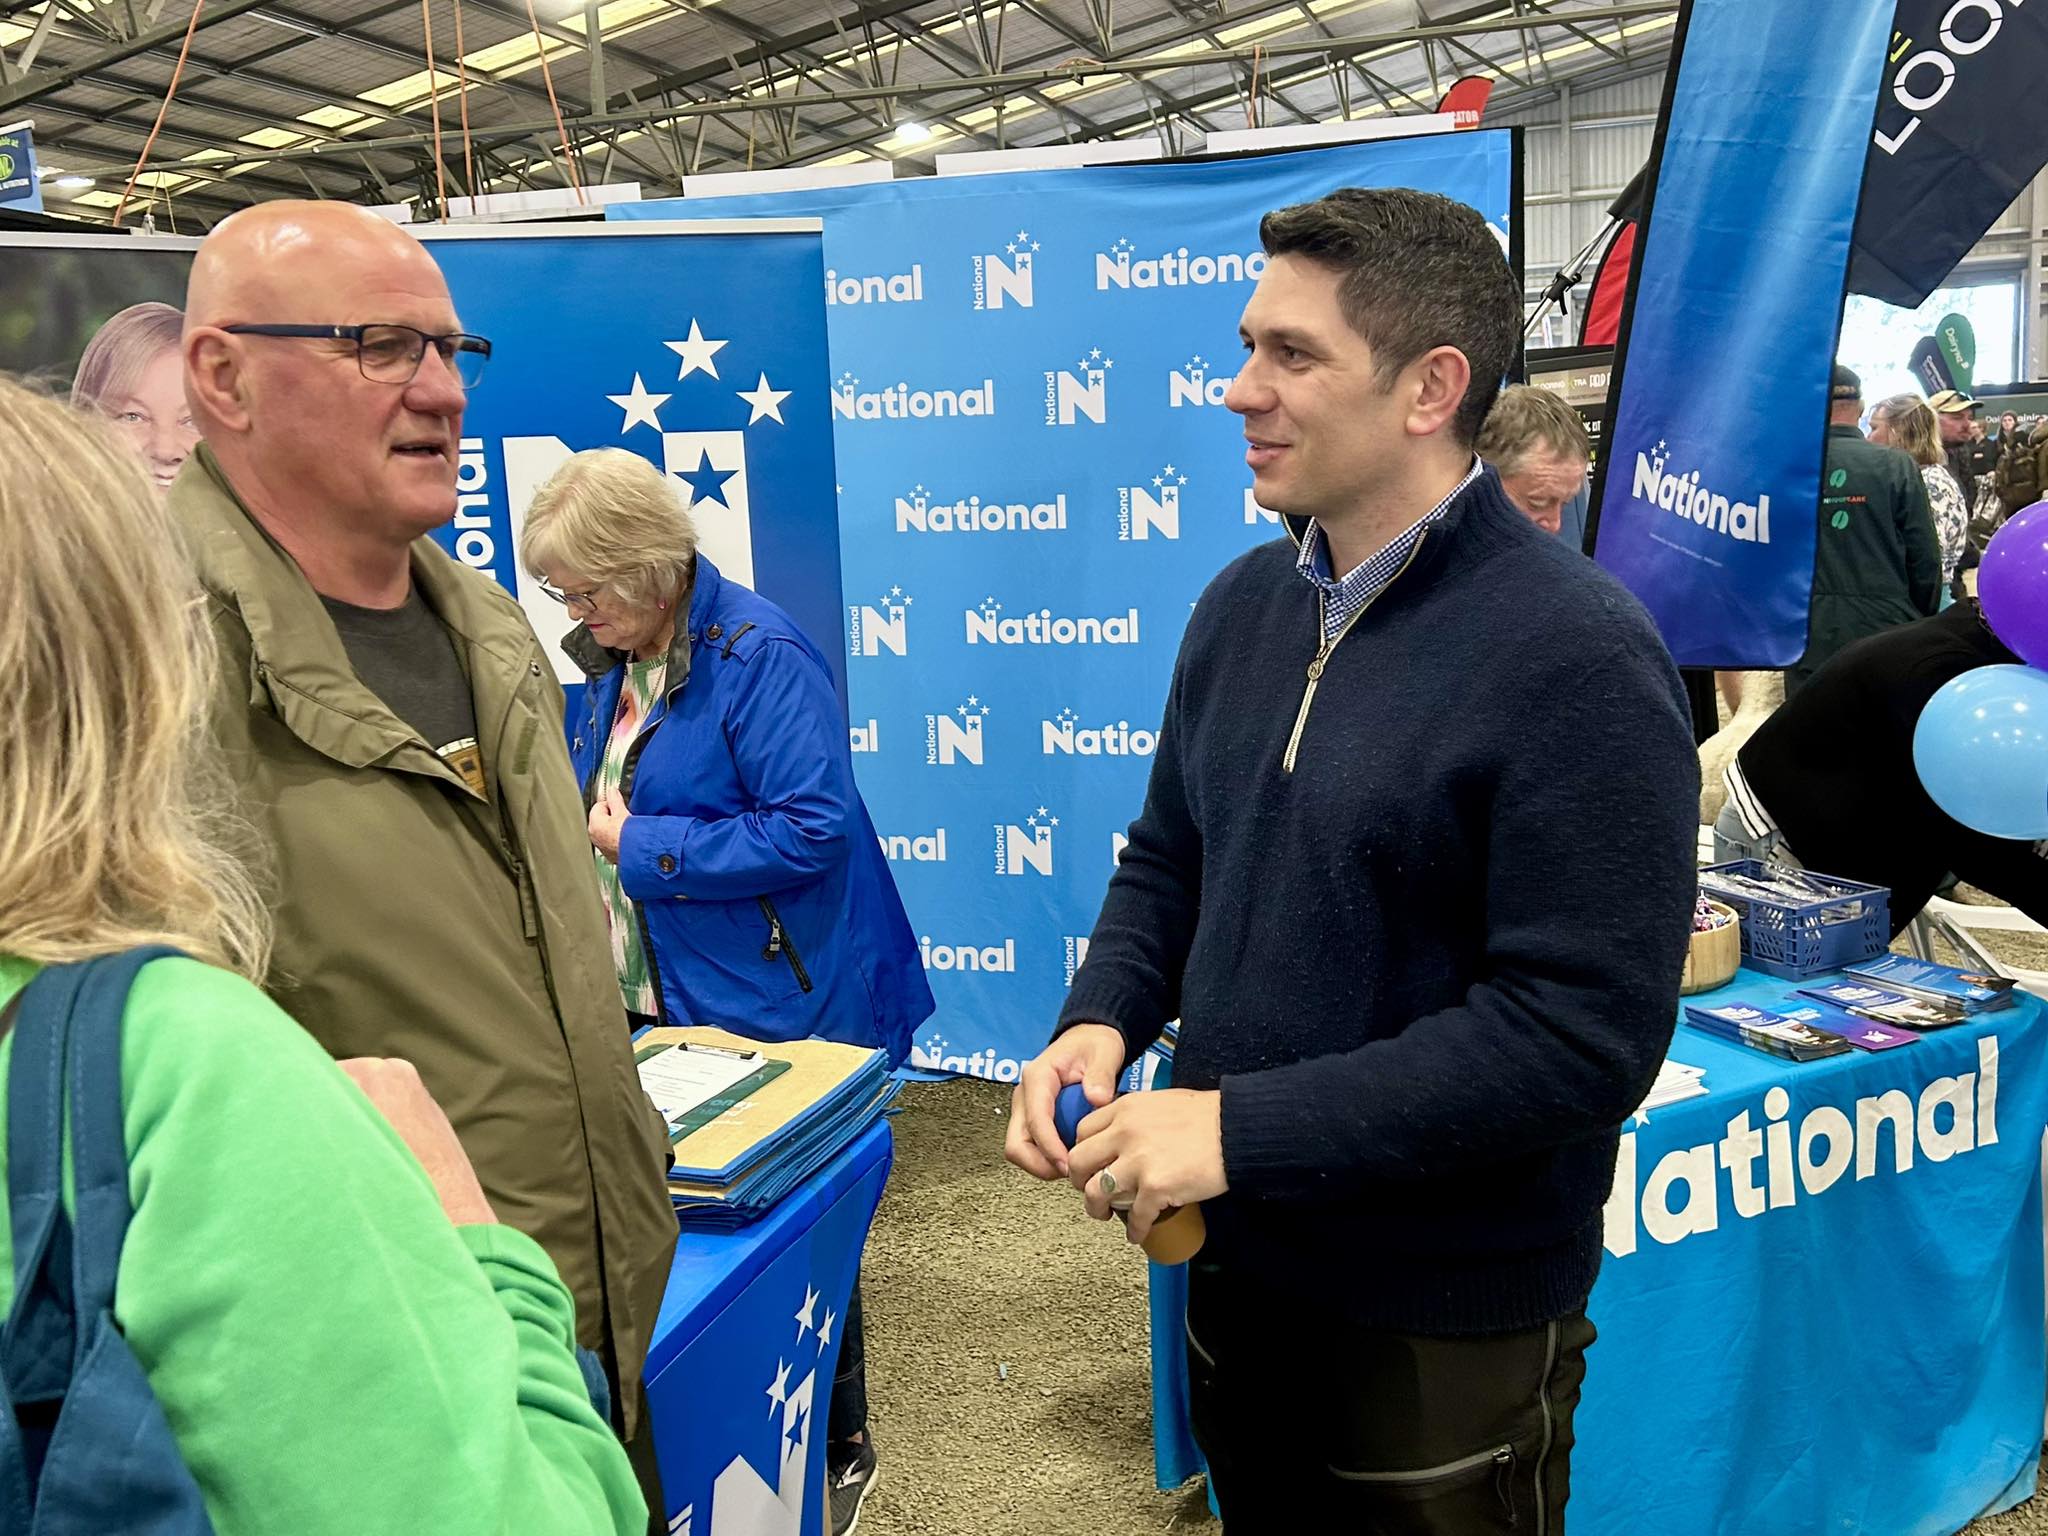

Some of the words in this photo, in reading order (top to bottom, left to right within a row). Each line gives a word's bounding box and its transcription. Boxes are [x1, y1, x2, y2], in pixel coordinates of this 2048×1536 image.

[1874, 0, 2024, 155] LOO
[825, 264, 923, 305] ional
[972, 255, 984, 310] National
[985, 252, 1033, 309] N
[1097, 247, 1265, 290] Nationa
[830, 379, 994, 420] National
[1044, 371, 1057, 425] National
[1058, 369, 1106, 425] N
[895, 494, 1067, 532] National
[1118, 487, 1129, 541] National
[1131, 486, 1179, 540] N
[1632, 451, 1770, 544] National
[849, 605, 861, 656] National
[861, 605, 907, 656] N
[965, 608, 1139, 644] National
[926, 714, 937, 765] National
[938, 714, 983, 765] N
[1042, 720, 1161, 756] Natio
[995, 824, 1005, 875] National
[1006, 824, 1053, 876] N
[918, 936, 1015, 972] ional
[1064, 936, 1074, 987] National
[911, 1045, 1030, 1082] Natio
